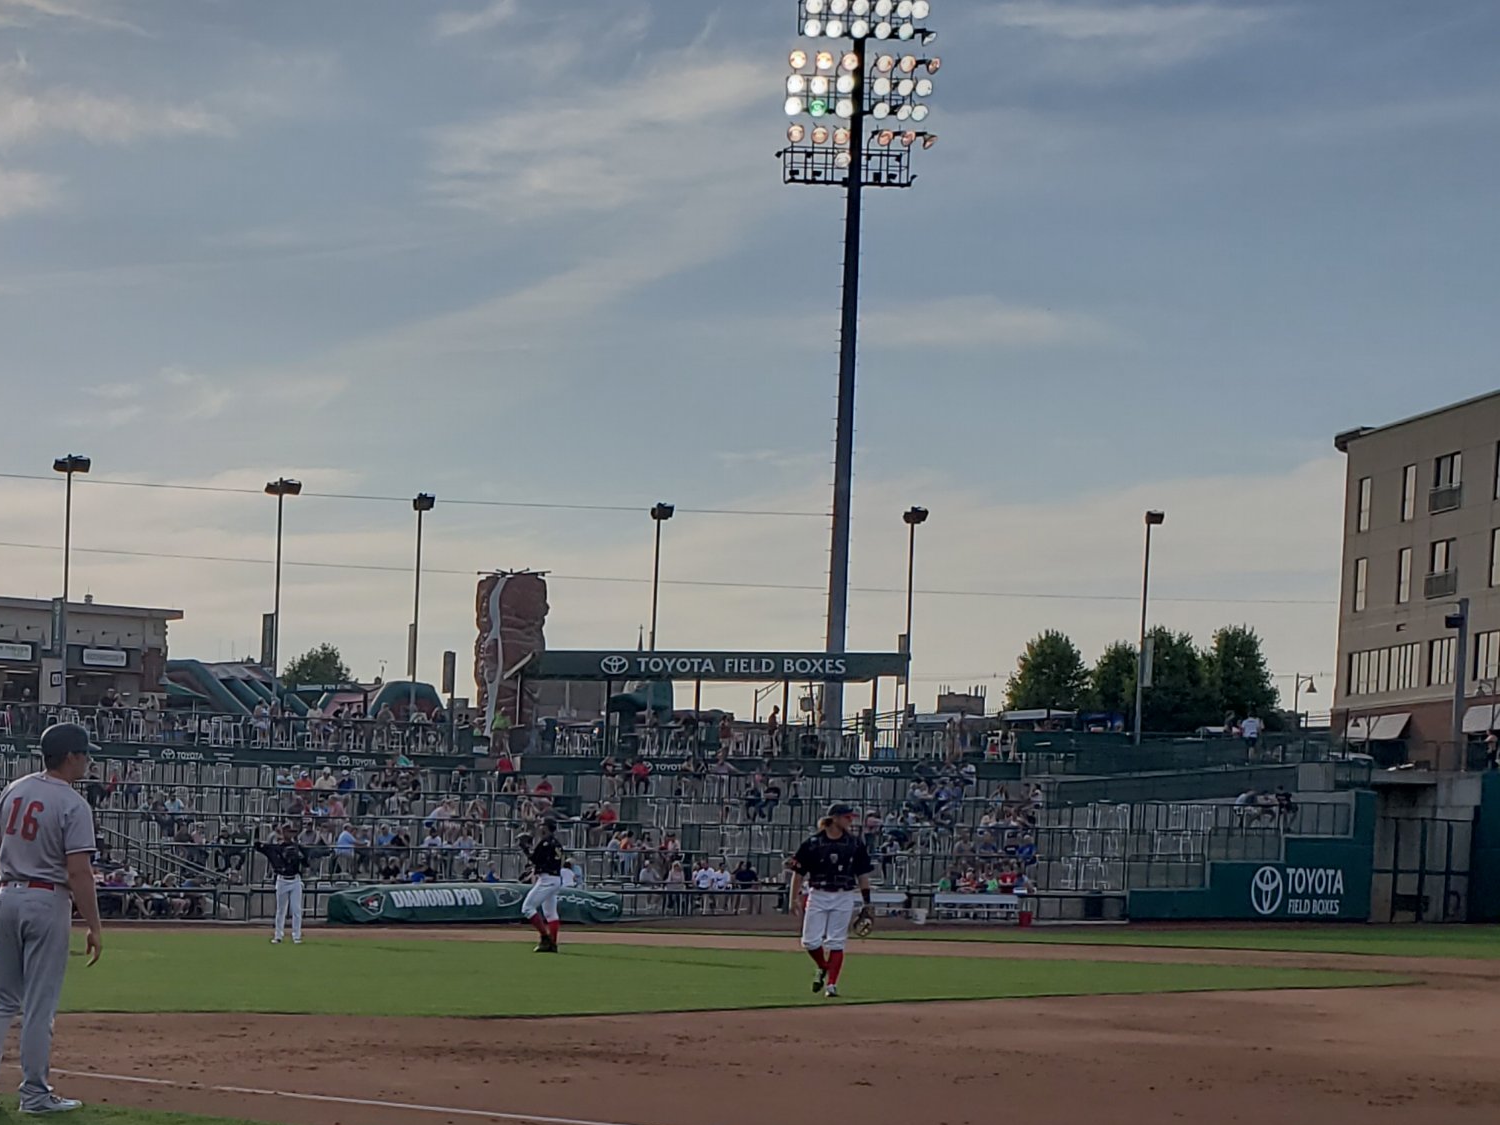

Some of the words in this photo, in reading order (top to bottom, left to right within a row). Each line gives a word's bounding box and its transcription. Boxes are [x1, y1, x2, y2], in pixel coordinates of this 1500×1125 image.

[636, 658, 715, 673] TOYOTA
[724, 659, 775, 673] FIELD
[783, 659, 846, 674] BOXES
[177, 752, 204, 760] TOYOTA
[352, 758, 377, 766] TOYOTA
[868, 766, 900, 774] TOYOTA
[5, 796, 44, 842] 16
[1286, 867, 1344, 894] TOYOTA
[390, 889, 456, 908] DIAMOND
[453, 888, 483, 906] PRO
[1288, 899, 1310, 914] FIELD
[1312, 900, 1340, 915] BOXES
